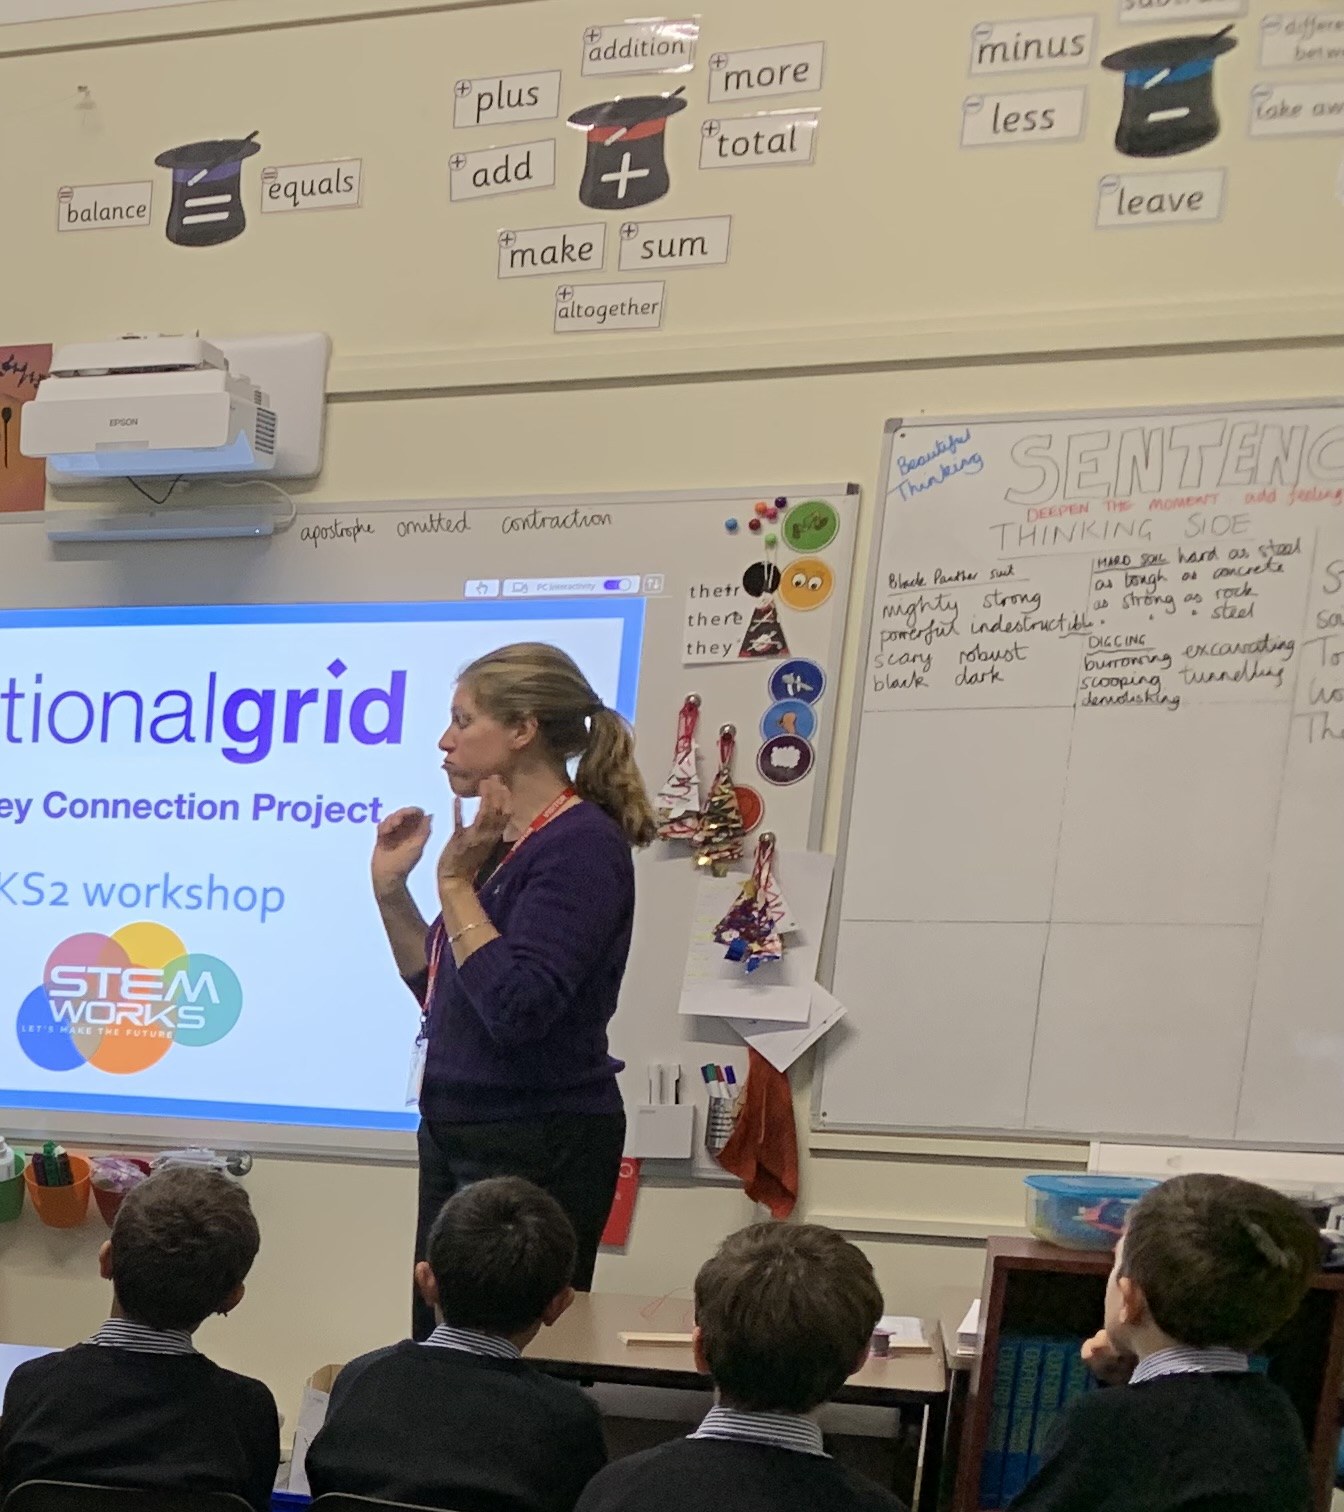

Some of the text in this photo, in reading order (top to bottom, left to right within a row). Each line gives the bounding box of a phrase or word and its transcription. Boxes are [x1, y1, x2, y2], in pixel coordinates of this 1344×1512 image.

[588, 34, 686, 62] addition
[977, 33, 1086, 65] minus
[724, 61, 810, 91] more
[476, 80, 540, 123] plus
[992, 102, 1056, 135] less
[717, 125, 798, 158] total
[472, 150, 533, 187] add
[268, 168, 354, 207] equals
[1116, 186, 1205, 216] leave
[67, 200, 147, 224] balance
[510, 233, 708, 269] make sum
[558, 298, 659, 324] altogether
[109, 418, 138, 427] EPSON
[897, 429, 971, 476] Beautiful
[886, 452, 984, 501] Thinking
[1026, 502, 1089, 523] DEEPEN
[1103, 499, 1134, 514] THE
[300, 508, 613, 549] apostrophe omitted contraction
[989, 511, 1252, 551] THINKING SIDE
[1097, 555, 1132, 569] HARD
[1178, 546, 1220, 564] hard
[1229, 548, 1249, 560] as
[690, 584, 741, 598] their
[1095, 578, 1113, 591] as
[1125, 570, 1168, 594] tough
[1213, 557, 1285, 580] concrete
[883, 588, 1042, 628] mighty strong
[1093, 581, 1259, 615] as strong as rock
[1211, 602, 1254, 620] steel
[688, 611, 743, 627] there
[880, 620, 960, 652] powerful
[1088, 633, 1147, 649] DIGGING
[874, 642, 1028, 673] scary robust
[874, 666, 1005, 692] black dark
[42, 791, 239, 822] Connection
[252, 792, 384, 829] Project
[543, 794, 568, 819] VISITOR
[83, 872, 285, 923] workshop
[49, 965, 221, 1004] STEM
[49, 1000, 206, 1030] WORKS
[21, 1024, 174, 1039] LET'S MAKE THE FUTURE
